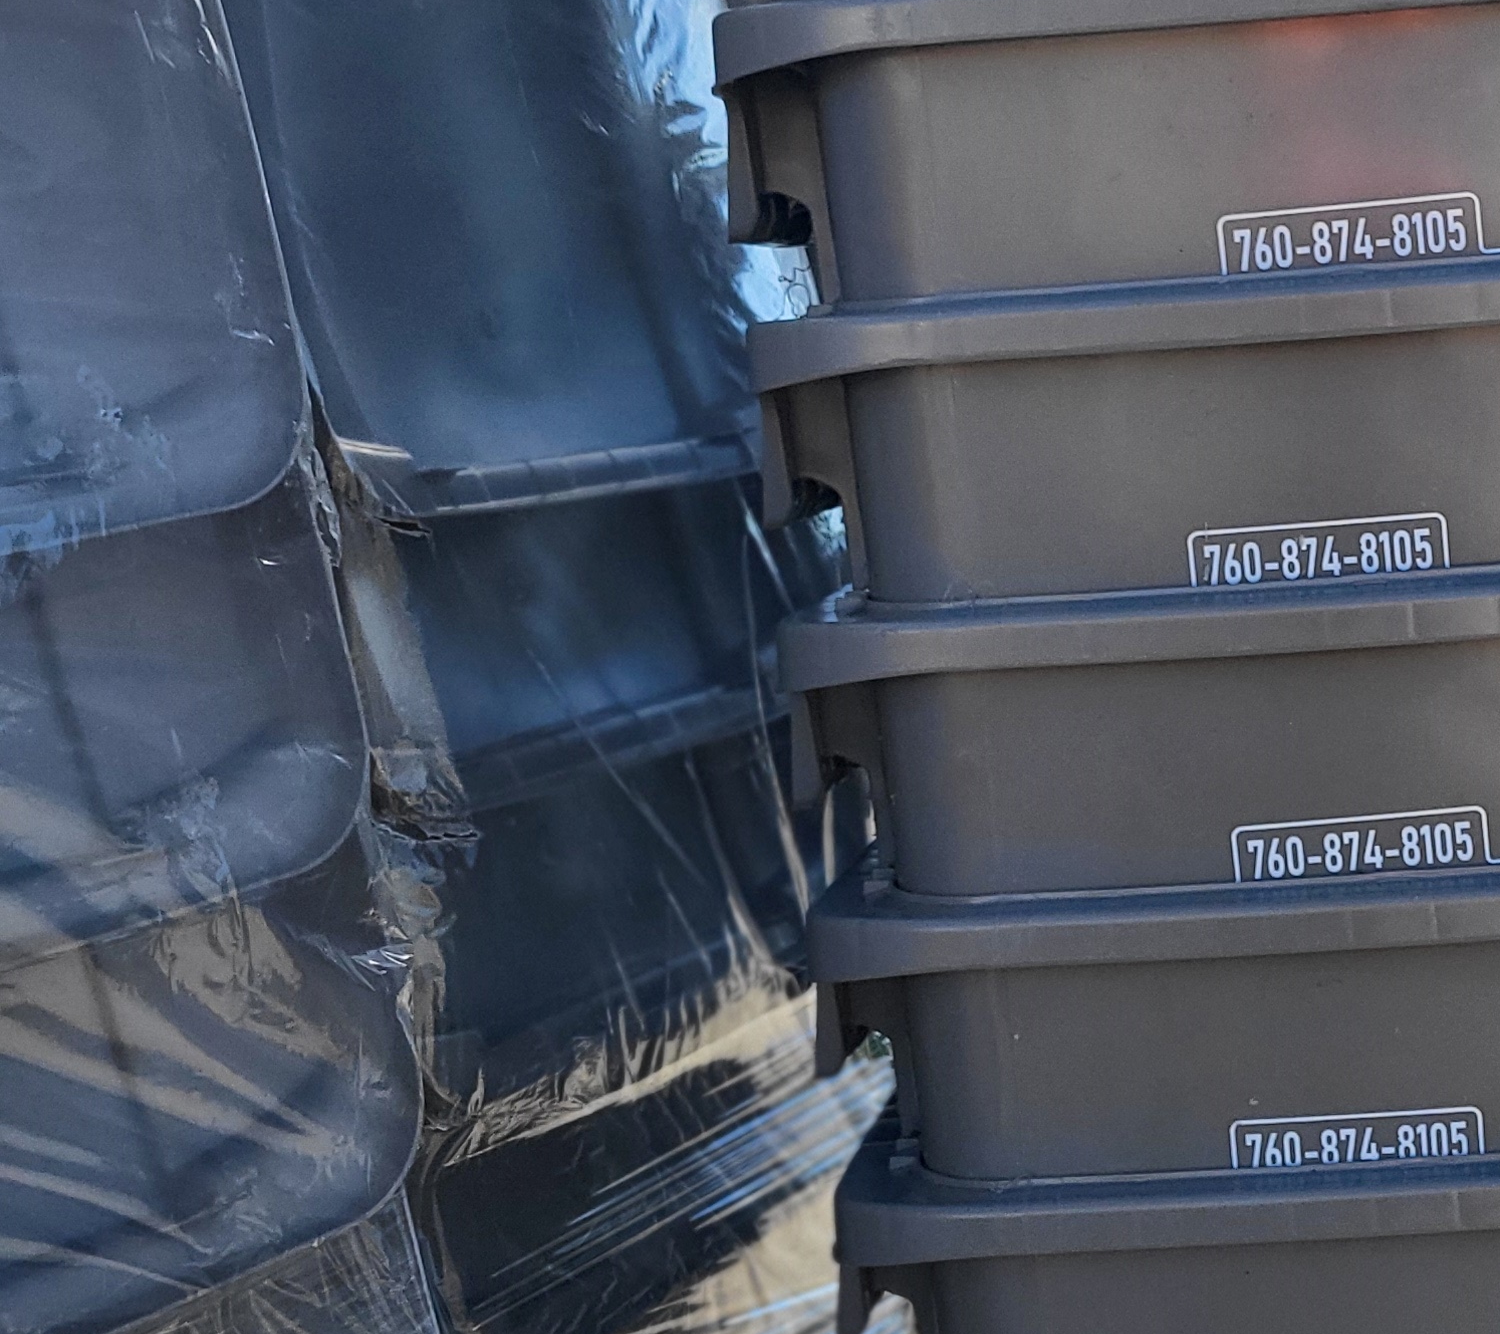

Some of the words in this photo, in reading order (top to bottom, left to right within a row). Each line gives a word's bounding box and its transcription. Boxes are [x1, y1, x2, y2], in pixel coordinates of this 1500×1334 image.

[1233, 209, 1467, 272] 760-874-8105
[1204, 528, 1433, 585] 760-874-8105
[1247, 821, 1474, 880] 760-874-8105
[1245, 1121, 1469, 1167] 760-874-8105
